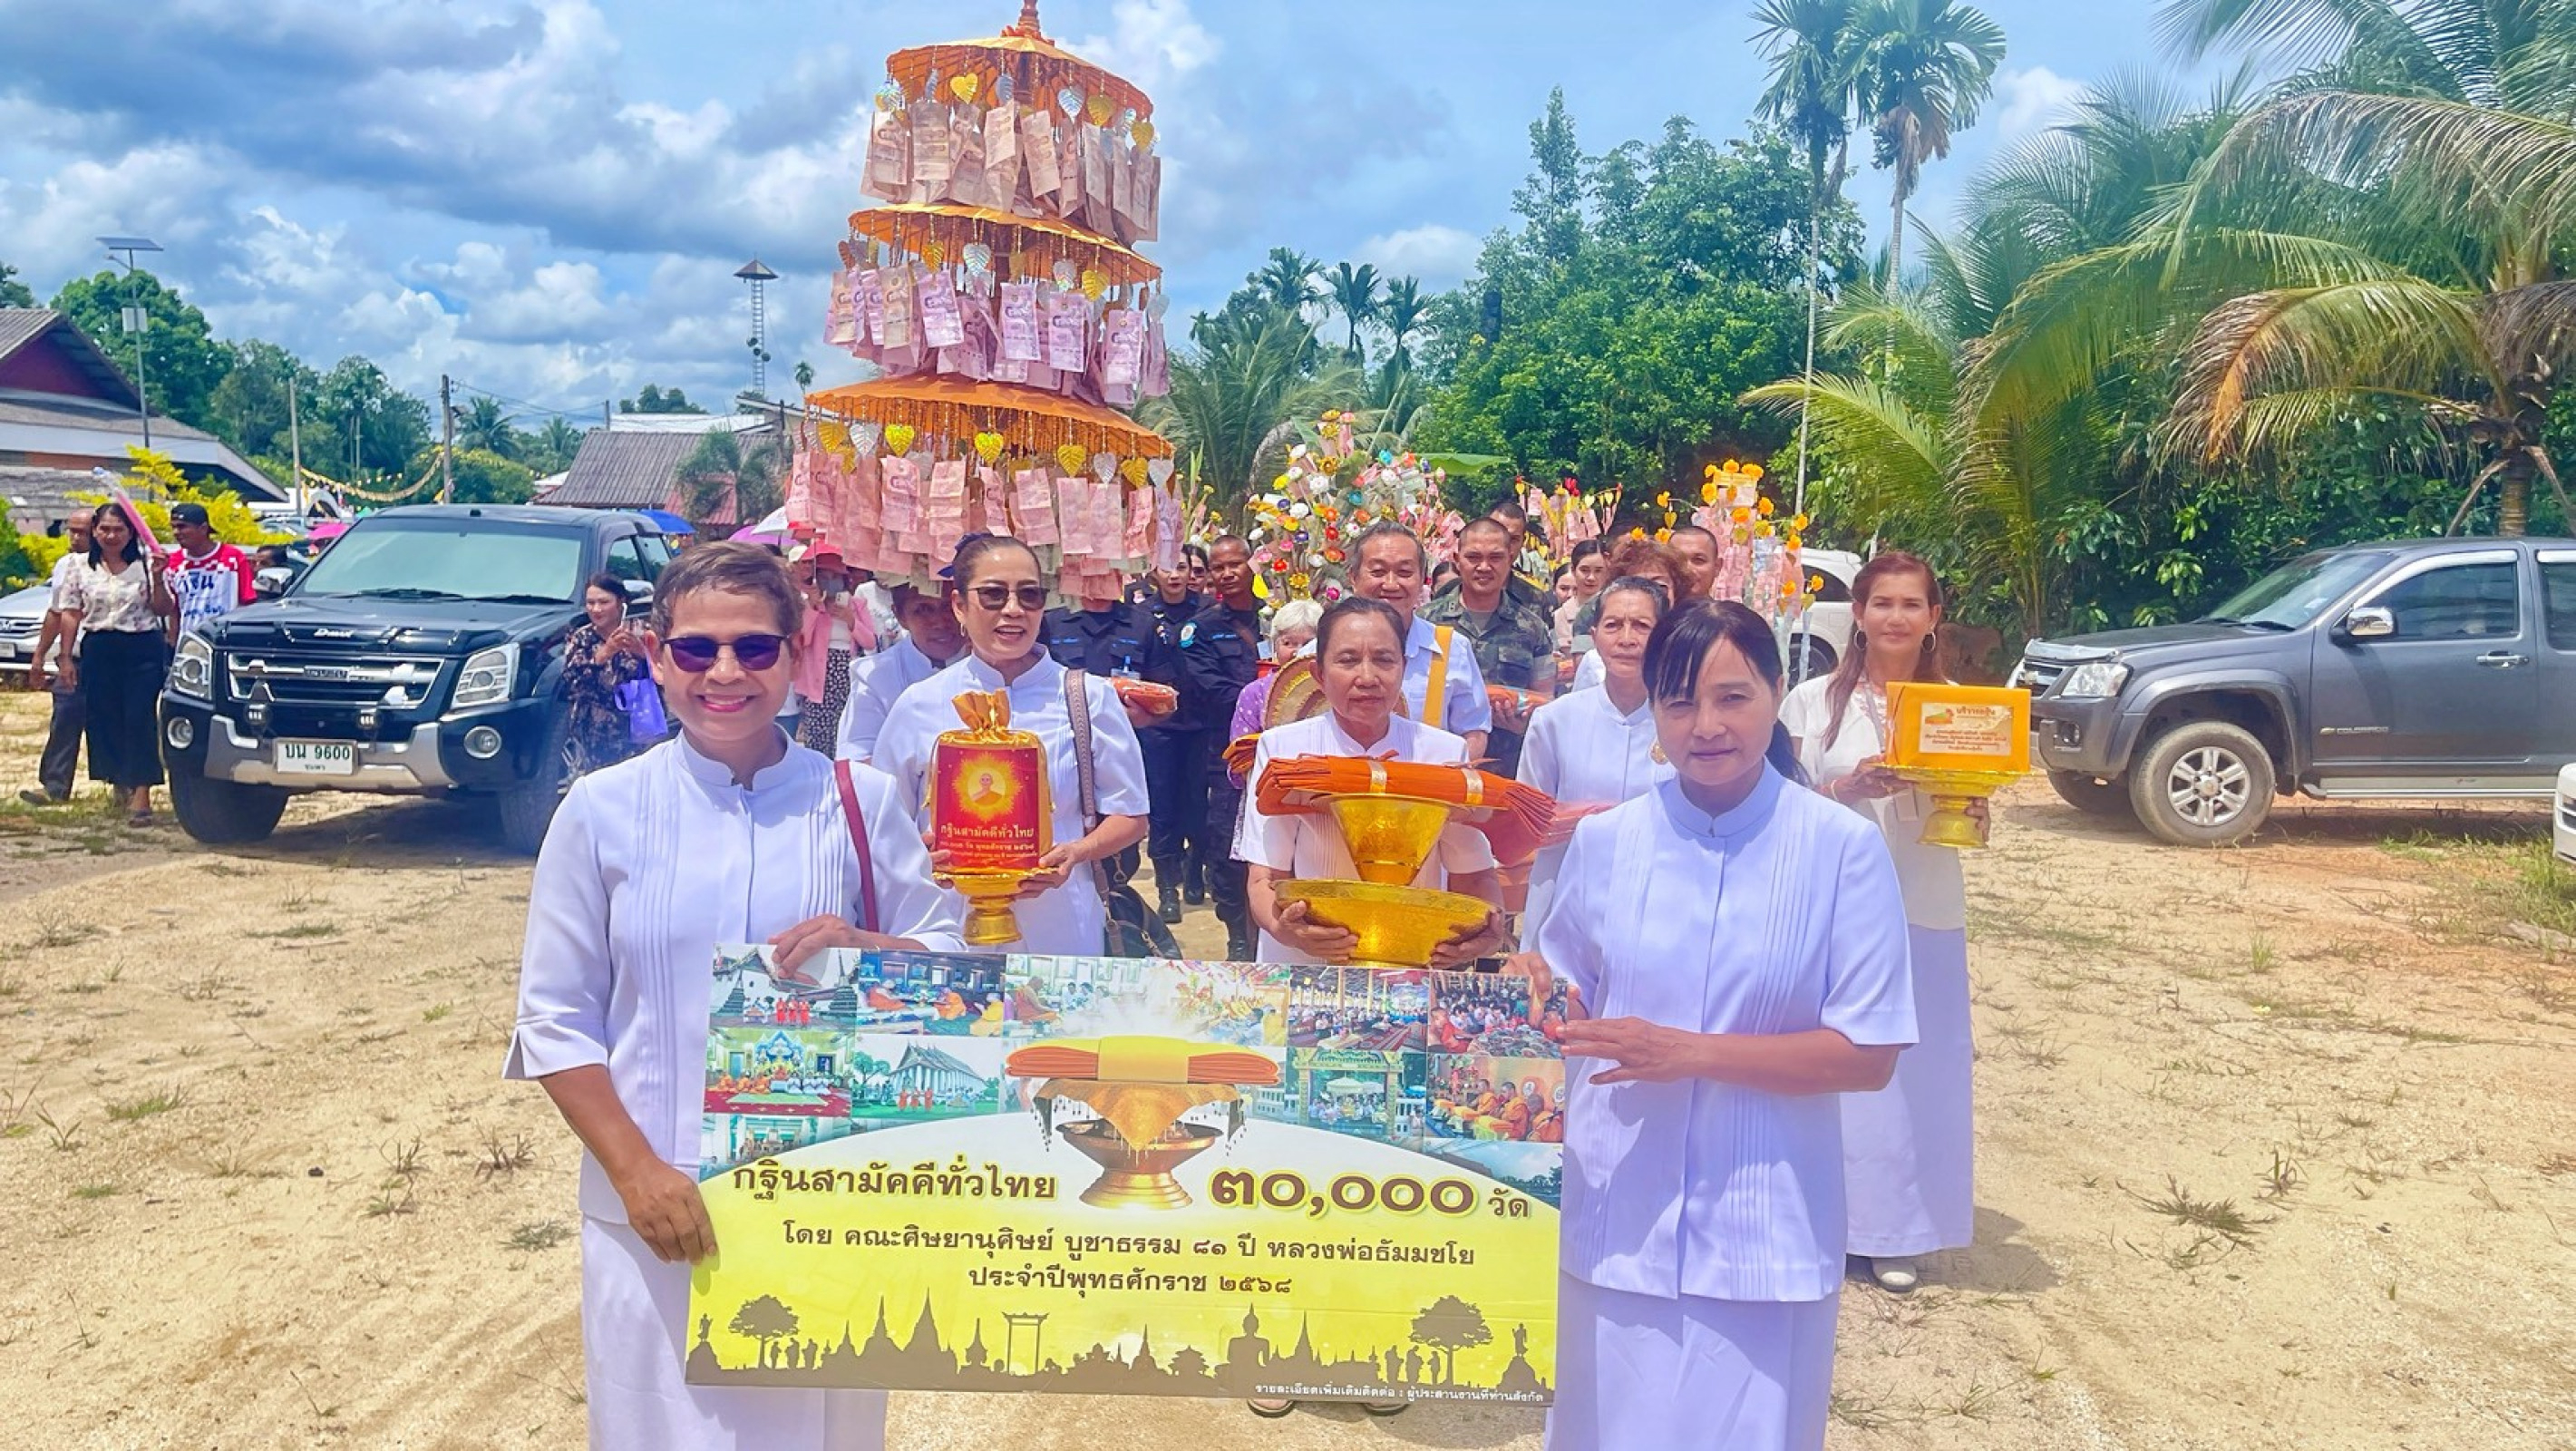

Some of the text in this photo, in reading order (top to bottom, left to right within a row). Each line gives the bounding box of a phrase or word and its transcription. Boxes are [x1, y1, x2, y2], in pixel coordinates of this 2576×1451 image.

[315, 745, 350, 760] 9600
[734, 1154, 1529, 1217] กฐินสามัคคีทั่วไทย ๓๐,๐๐๐ วัด
[783, 1220, 1475, 1265] โดย คณะศิษยานุศิษย์ บูชาธรรม ๘๑ ปี หลวงพ่อธัมมชโย
[968, 1263, 1292, 1299] ประจำปีพุทธศักราช ๒๕๖๘
